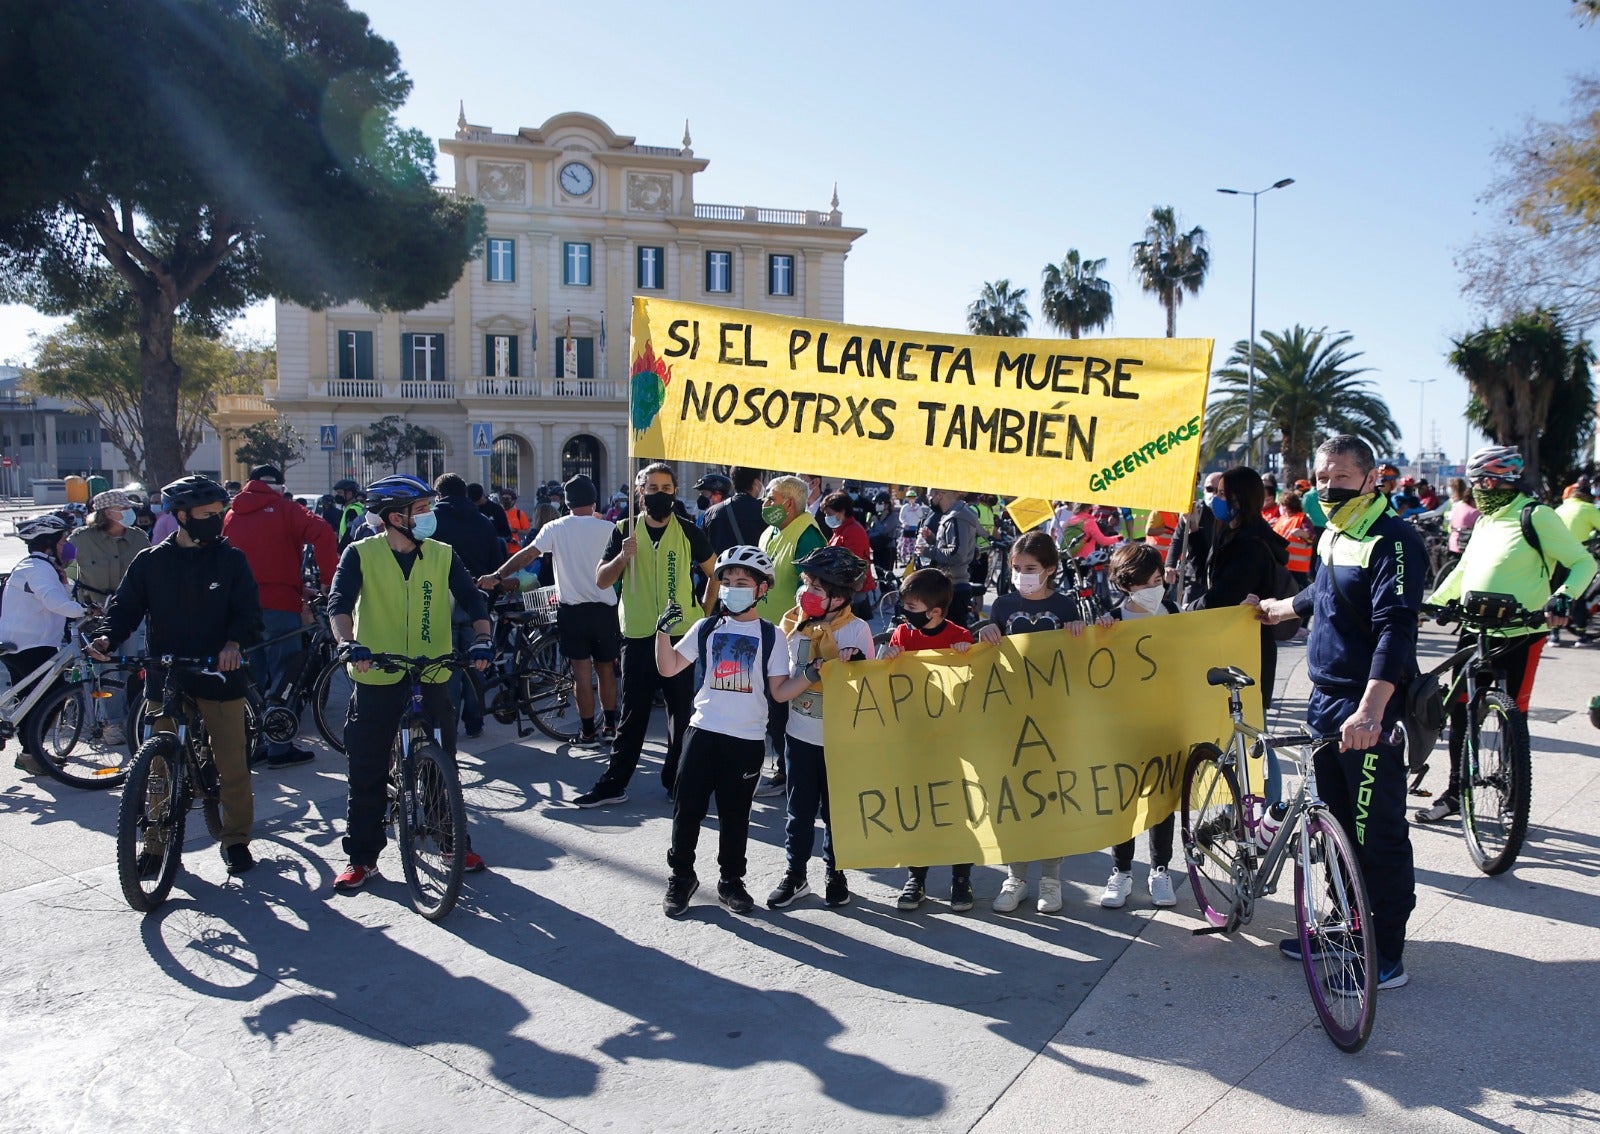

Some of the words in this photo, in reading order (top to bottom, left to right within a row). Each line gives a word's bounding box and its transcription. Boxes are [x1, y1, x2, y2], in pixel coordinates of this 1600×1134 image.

[664, 319, 700, 360] SI
[718, 322, 768, 368] EL
[789, 329, 976, 386] PLANETA
[994, 350, 1144, 400] MUERE
[680, 379, 897, 441] NOSOTRXS
[918, 400, 1098, 462] TAMBIÉN
[1088, 415, 1201, 493] GREENPEACE
[1394, 541, 1405, 596] GIVOVA
[421, 580, 433, 644] GREENPEACE
[852, 634, 1158, 730] APOYAMOS
[1012, 715, 1057, 768] A
[1056, 737, 1220, 816] REDON
[1355, 753, 1379, 846] GIVOVA
